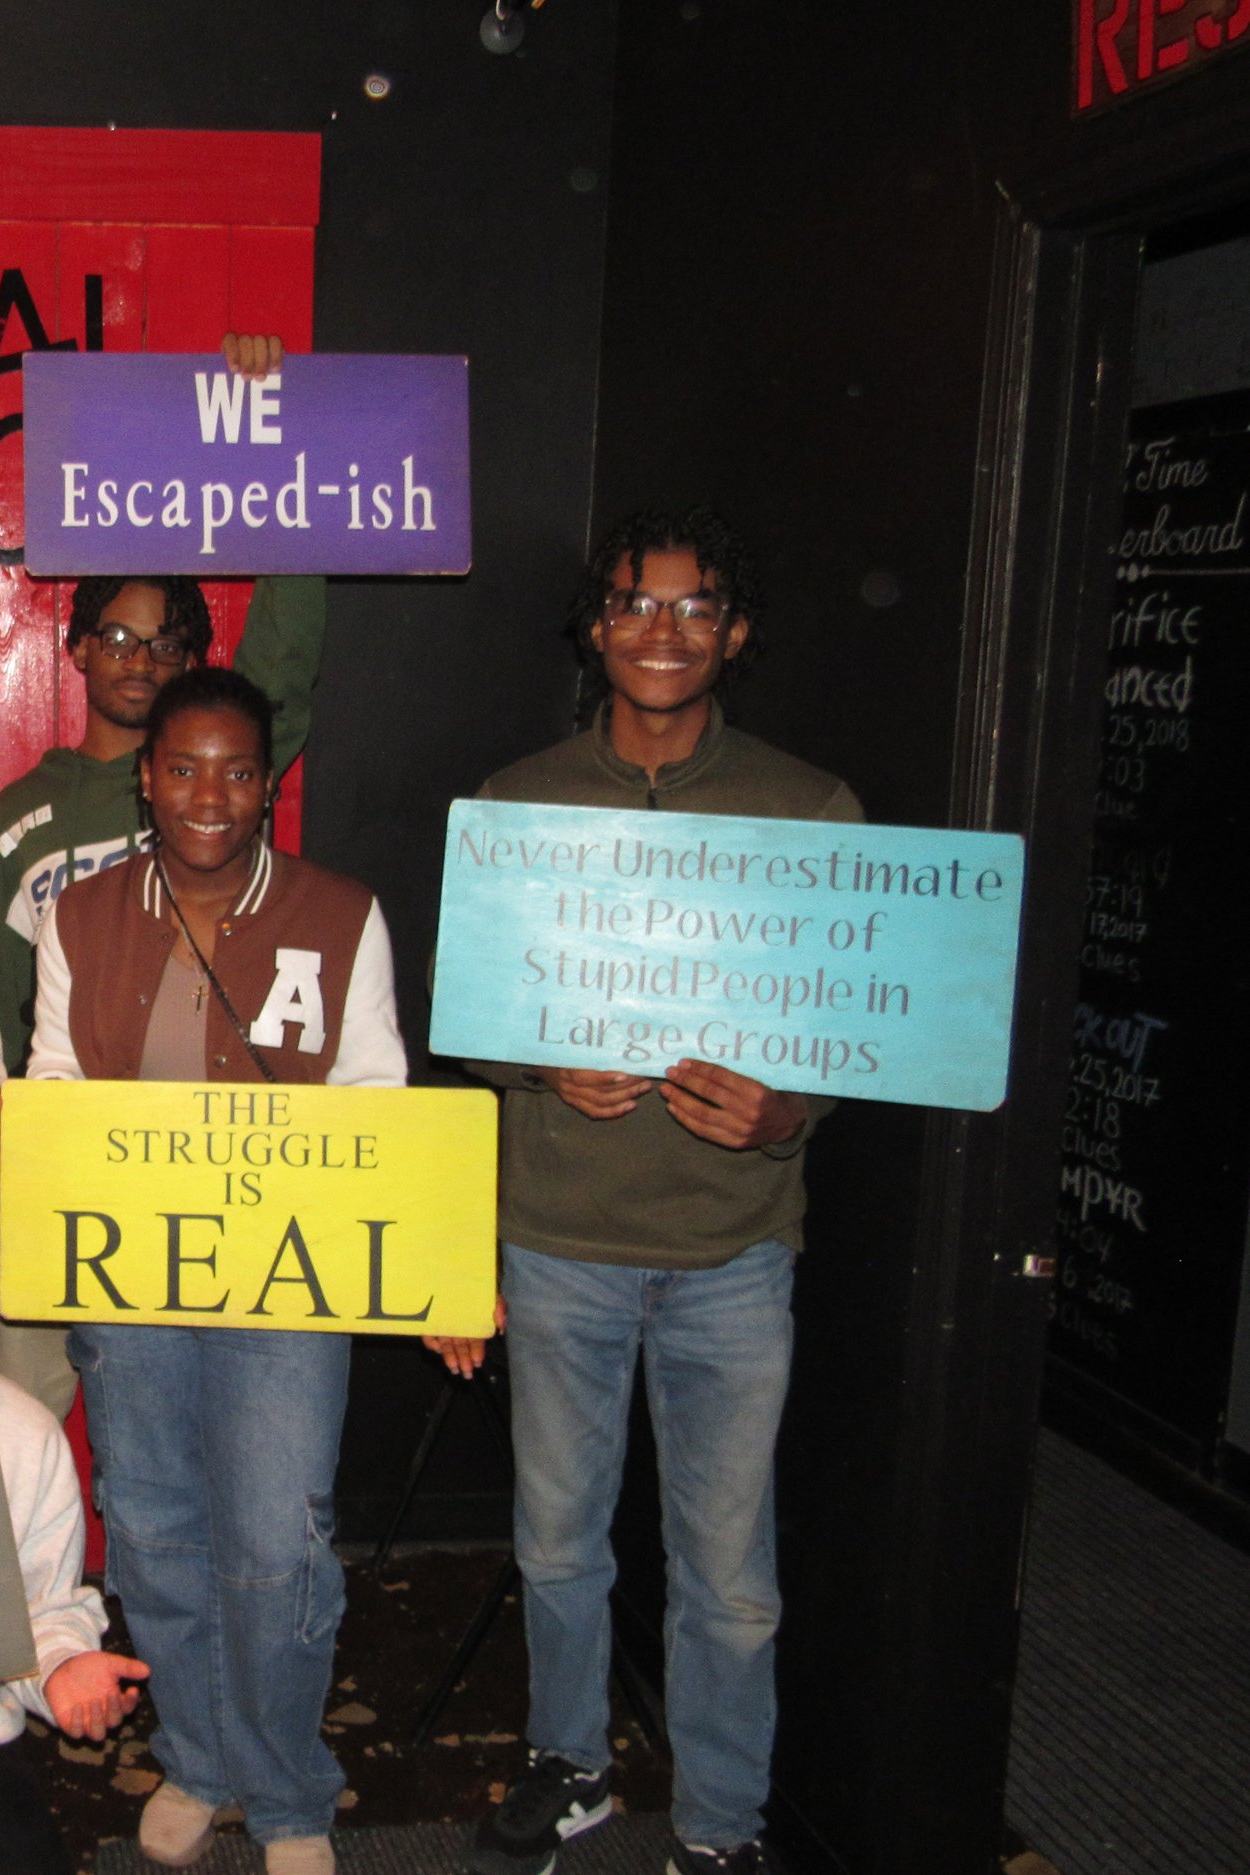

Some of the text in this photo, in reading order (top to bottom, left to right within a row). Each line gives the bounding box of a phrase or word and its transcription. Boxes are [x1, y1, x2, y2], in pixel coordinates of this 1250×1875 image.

[195, 373, 283, 445] WE
[1136, 435, 1209, 491] Time
[60, 453, 437, 554] Escaped-ish
[1107, 491, 1246, 557] erboard
[456, 828, 1004, 902] Never Underestimate
[645, 899, 813, 948] Power
[827, 911, 889, 953] of
[251, 948, 326, 1055] A
[521, 947, 910, 1017] Stupid People in
[538, 1006, 881, 1081] Large Groups
[193, 1091, 292, 1127] THE
[106, 1128, 379, 1170] STRUGGLE
[223, 1171, 263, 1207] IS
[52, 1209, 435, 1322] REAL
